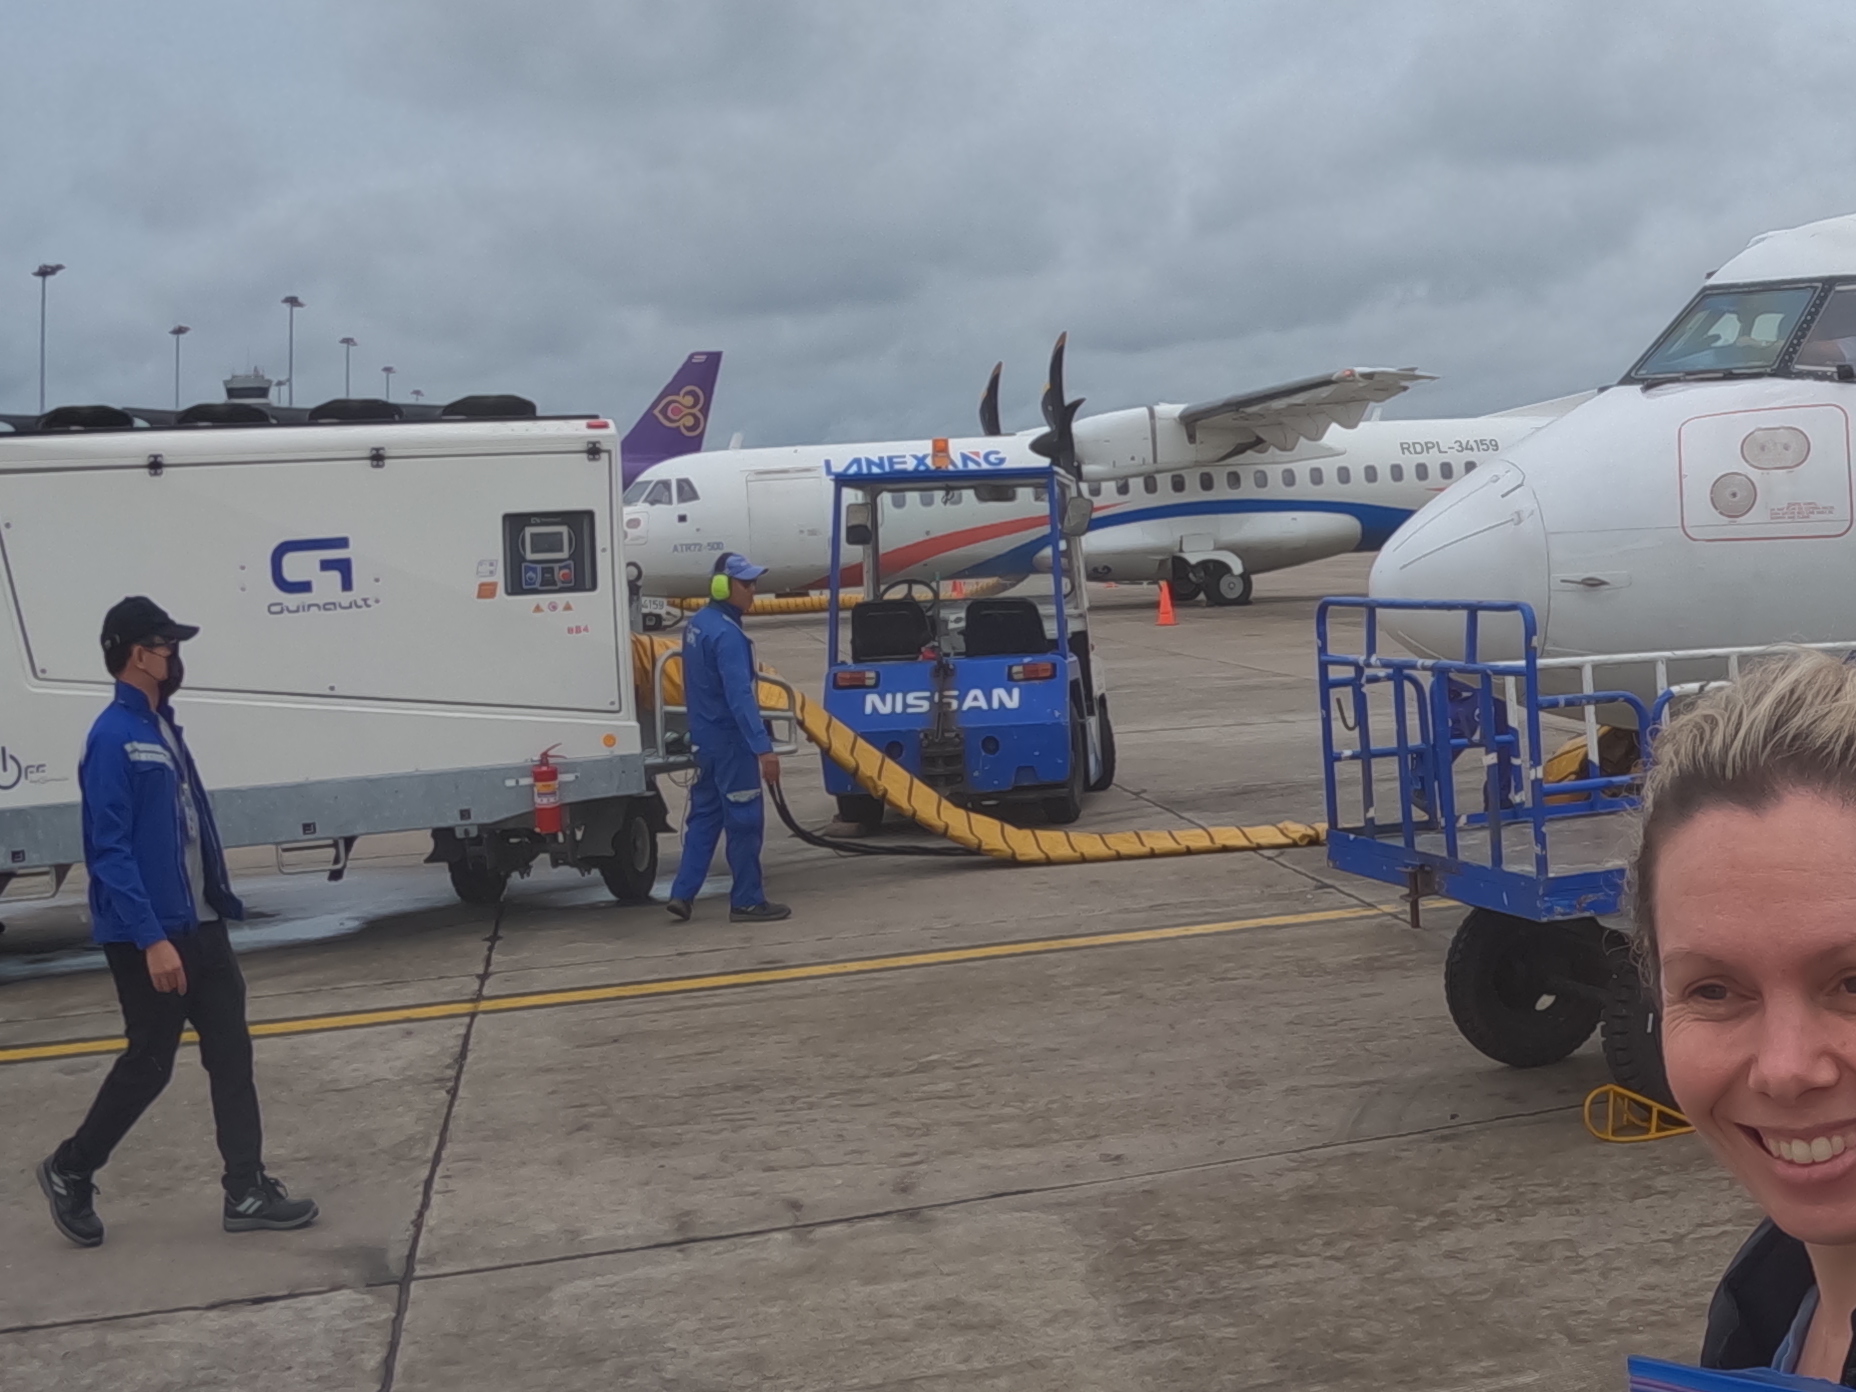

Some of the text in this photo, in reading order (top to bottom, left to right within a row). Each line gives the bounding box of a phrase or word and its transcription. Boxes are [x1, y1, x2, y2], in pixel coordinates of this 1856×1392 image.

[1399, 438, 1500, 456] RDPL-34159
[267, 597, 372, 615] Guinault
[864, 687, 1020, 715] NISSAN
